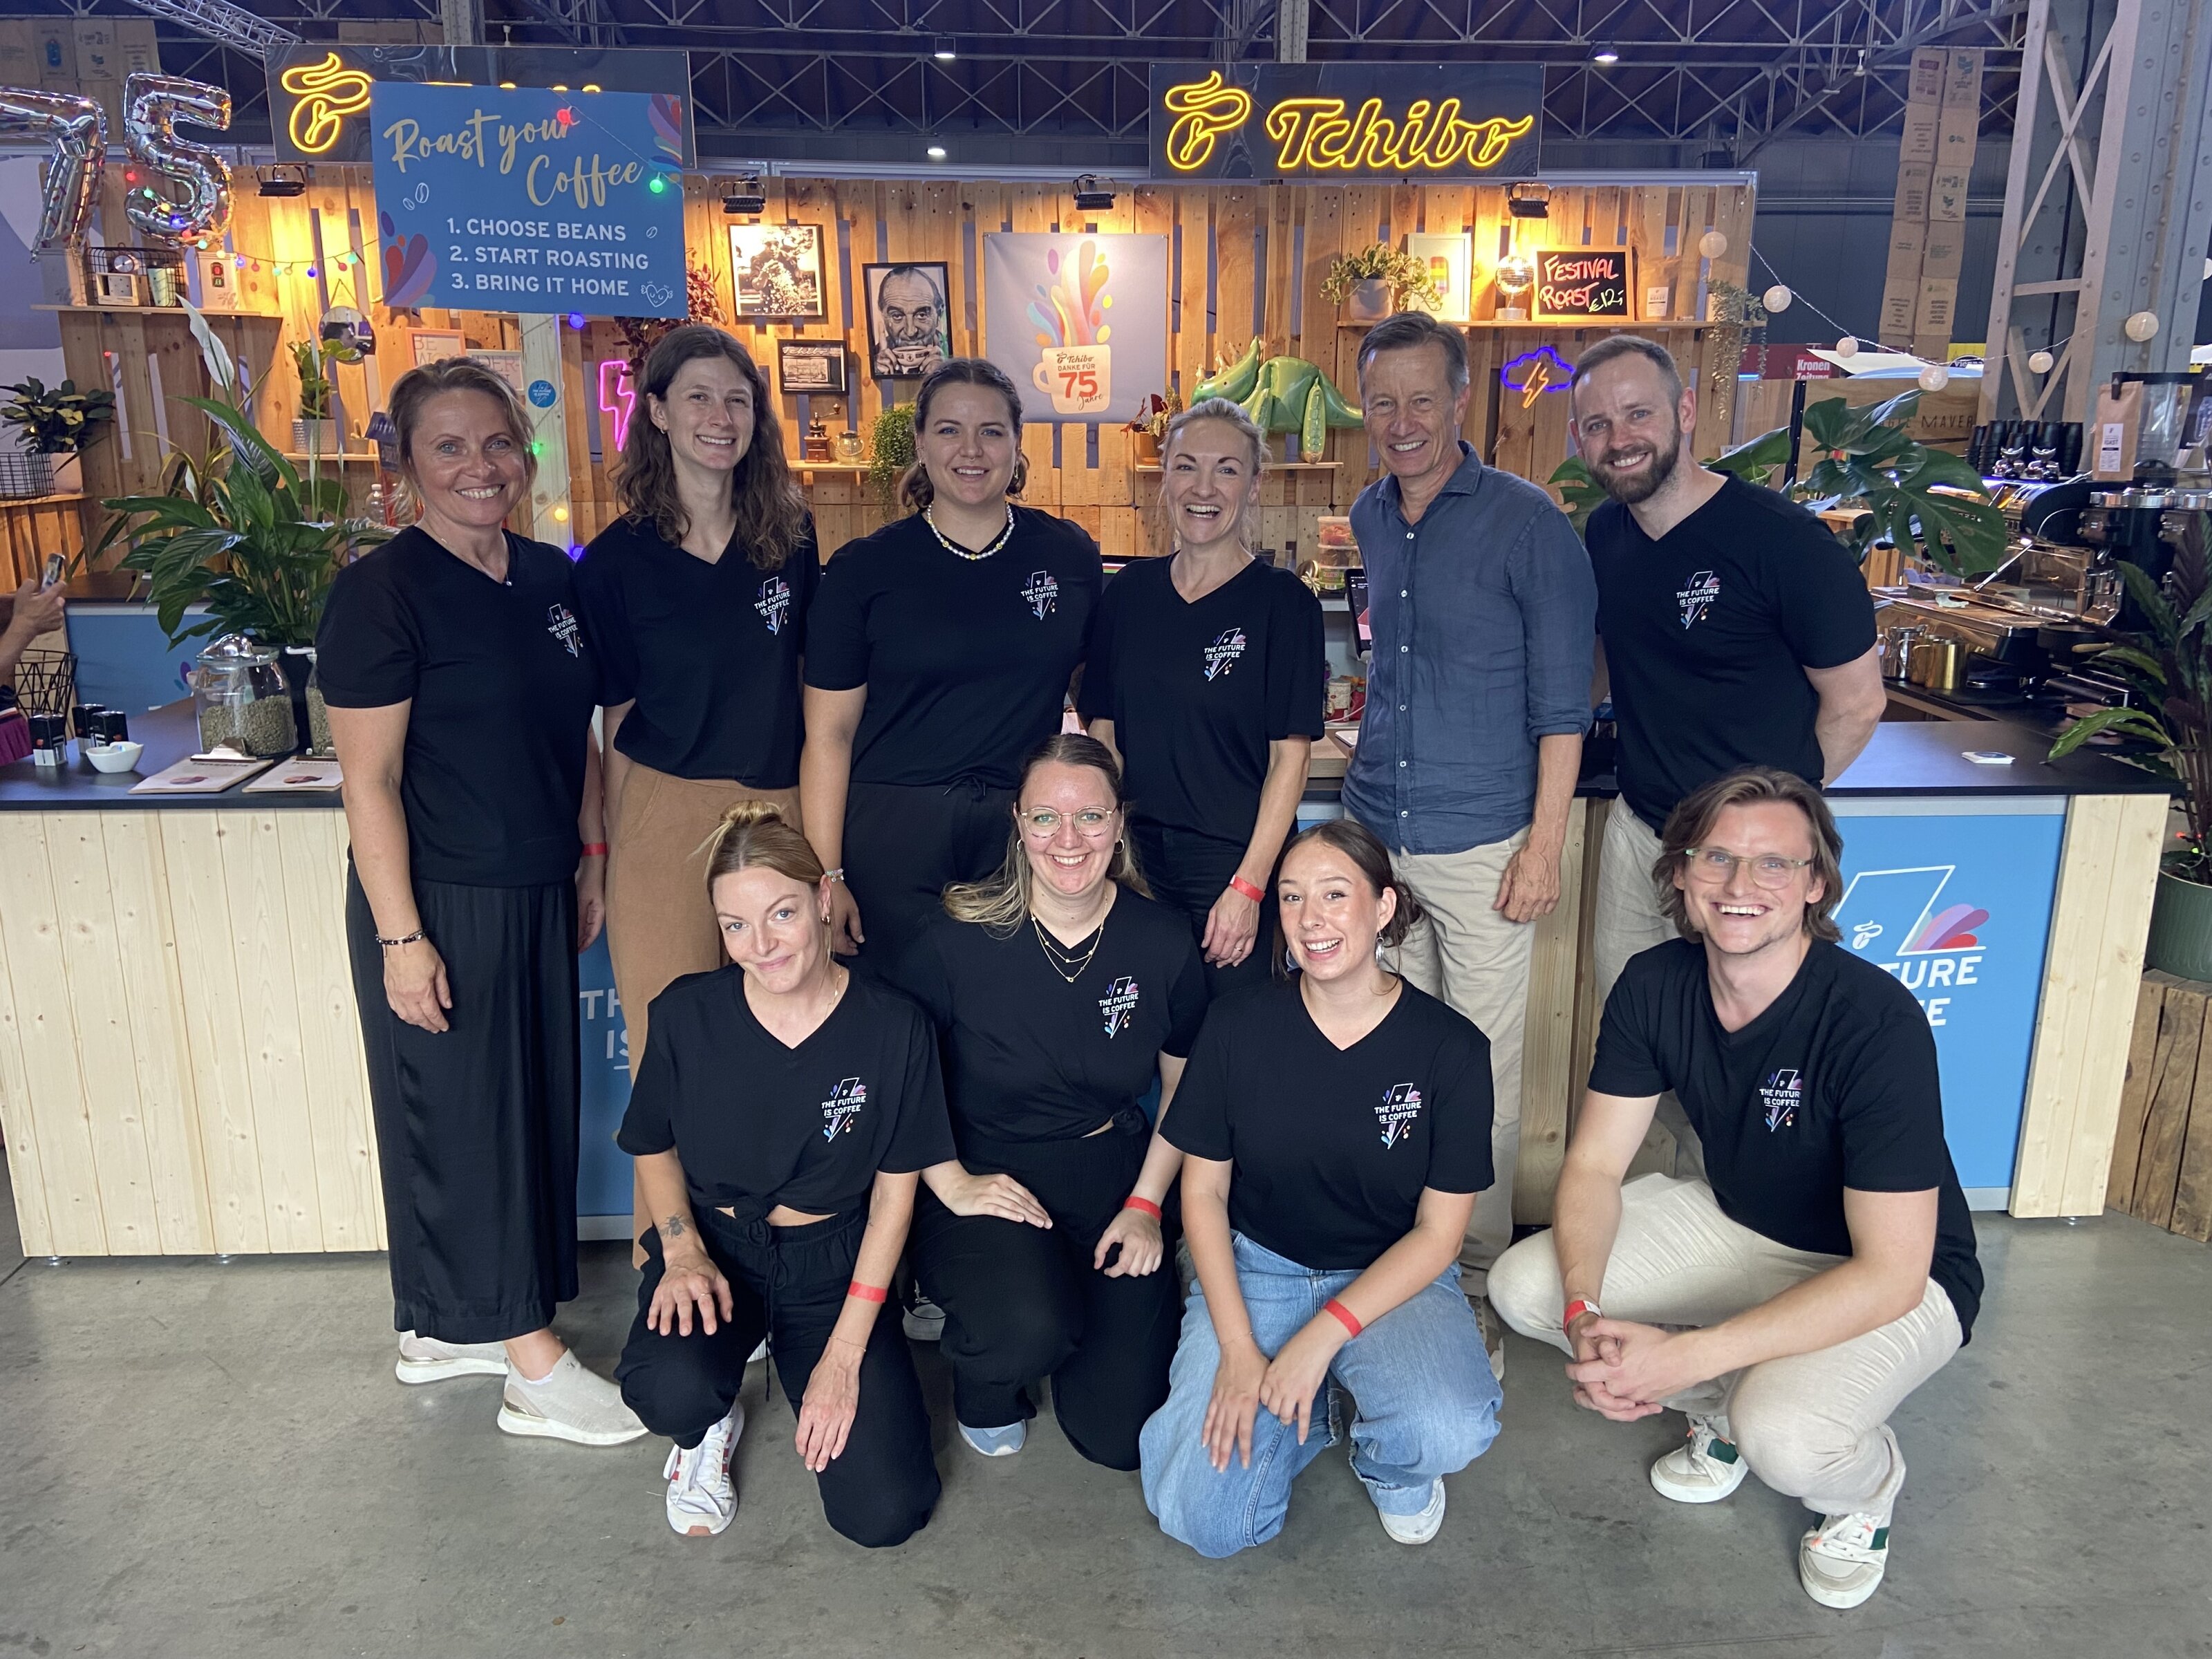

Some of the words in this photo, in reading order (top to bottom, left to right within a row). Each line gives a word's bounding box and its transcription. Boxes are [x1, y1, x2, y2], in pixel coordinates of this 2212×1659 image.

[1266, 98, 1533, 169] Tchibo
[383, 109, 501, 173] Roast
[527, 153, 644, 209] Coffee
[447, 218, 461, 234] 1.
[467, 218, 550, 238] CHOOSE
[557, 223, 627, 241] BEANS
[449, 245, 469, 262] 2.
[475, 247, 540, 265] START
[547, 250, 649, 270] ROASTING
[1544, 254, 1619, 282] FESTIVAL
[451, 273, 469, 290] 3.
[476, 274, 540, 292] BRING
[547, 276, 564, 293] IT
[572, 278, 630, 296] HOME
[1539, 282, 1600, 310] ROAST
[1067, 355, 1094, 364] Tchibo
[1797, 359, 1830, 371] Kronen
[1058, 371, 1098, 398] 75
[1077, 393, 1104, 411] Jahre
[1035, 585, 1058, 593] FUTURE
[1035, 591, 1058, 599] COFFEE
[1691, 588, 1720, 597] FUTURE
[754, 600, 767, 609] THE
[767, 591, 790, 604] FUTURE
[767, 599, 789, 612] COFFEE
[1687, 595, 1714, 603] COFFEE
[547, 624, 559, 633] THE
[557, 617, 577, 629] FUTURE
[561, 624, 578, 636] COFFEE
[1114, 993, 1138, 1004] FUTURE
[1112, 1002, 1135, 1012] COFFEE
[821, 1100, 836, 1109] THE
[837, 1096, 866, 1106] FUTURE
[1391, 1101, 1421, 1112] FUTURE
[1772, 1098, 1800, 1107] COFFEE
[834, 1105, 861, 1114] COFFEE
[1388, 1110, 1417, 1120] COFFEE
